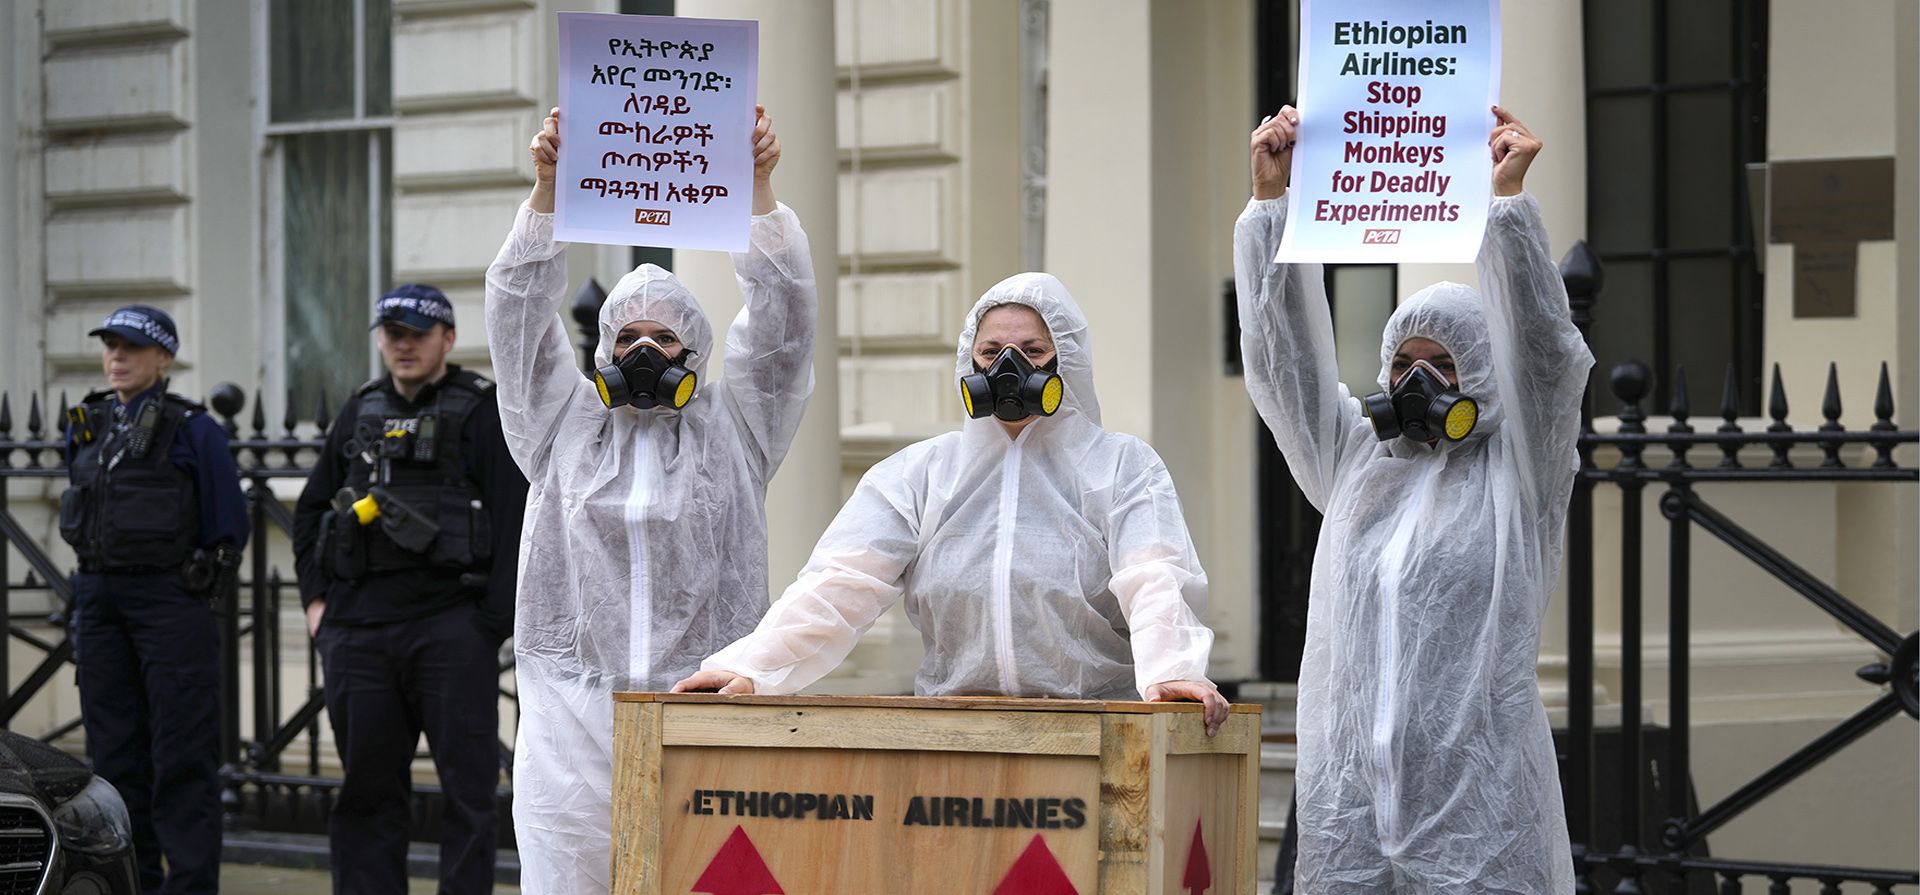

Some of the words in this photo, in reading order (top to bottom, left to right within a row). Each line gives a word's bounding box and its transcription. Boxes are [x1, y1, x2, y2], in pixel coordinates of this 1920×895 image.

[1334, 20, 1467, 48] Ethiopian
[608, 38, 715, 62] የኢትዮጵያ
[591, 64, 637, 89] አየር
[1339, 52, 1457, 76] Airlines:
[623, 92, 691, 116] ለገዳይ
[1366, 81, 1422, 107] Stop
[598, 121, 714, 147] ሙከራዎች
[1343, 111, 1447, 138] Shipping
[601, 150, 709, 174] ጦጣዎችን
[1343, 141, 1445, 168] Monkeys
[580, 177, 659, 201] ማጓጓዝ
[665, 182, 729, 204] አቁም
[1332, 170, 1365, 193] for
[1370, 171, 1451, 197] Deadly
[1314, 200, 1460, 225] Experiments
[693, 789, 874, 821] ETHIOPIAN
[903, 796, 1087, 829] AIRLINES
